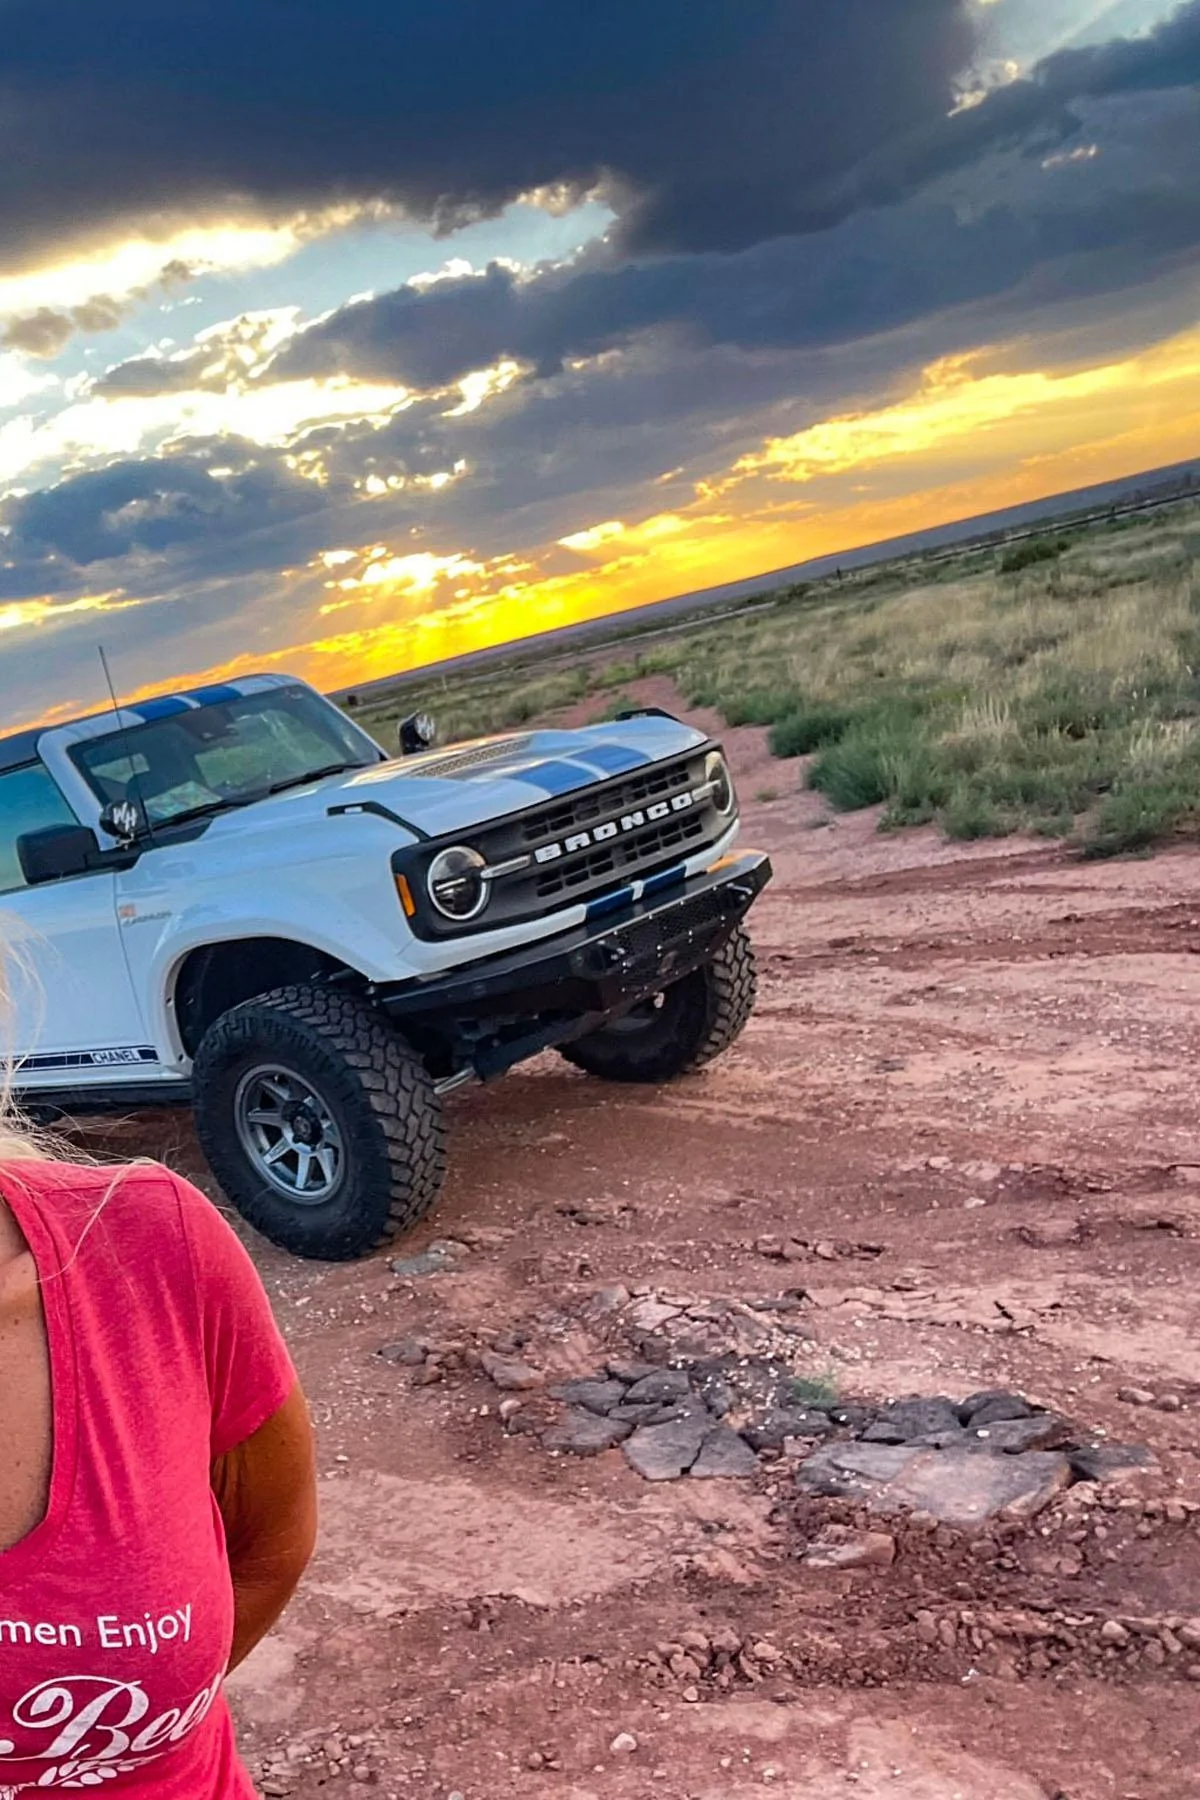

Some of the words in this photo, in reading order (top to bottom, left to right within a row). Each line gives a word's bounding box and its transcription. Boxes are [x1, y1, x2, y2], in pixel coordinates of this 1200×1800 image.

[534, 792, 693, 864] BRONCO
[91, 1049, 140, 1065] CHANEL
[96, 1603, 192, 1655] Enjoy
